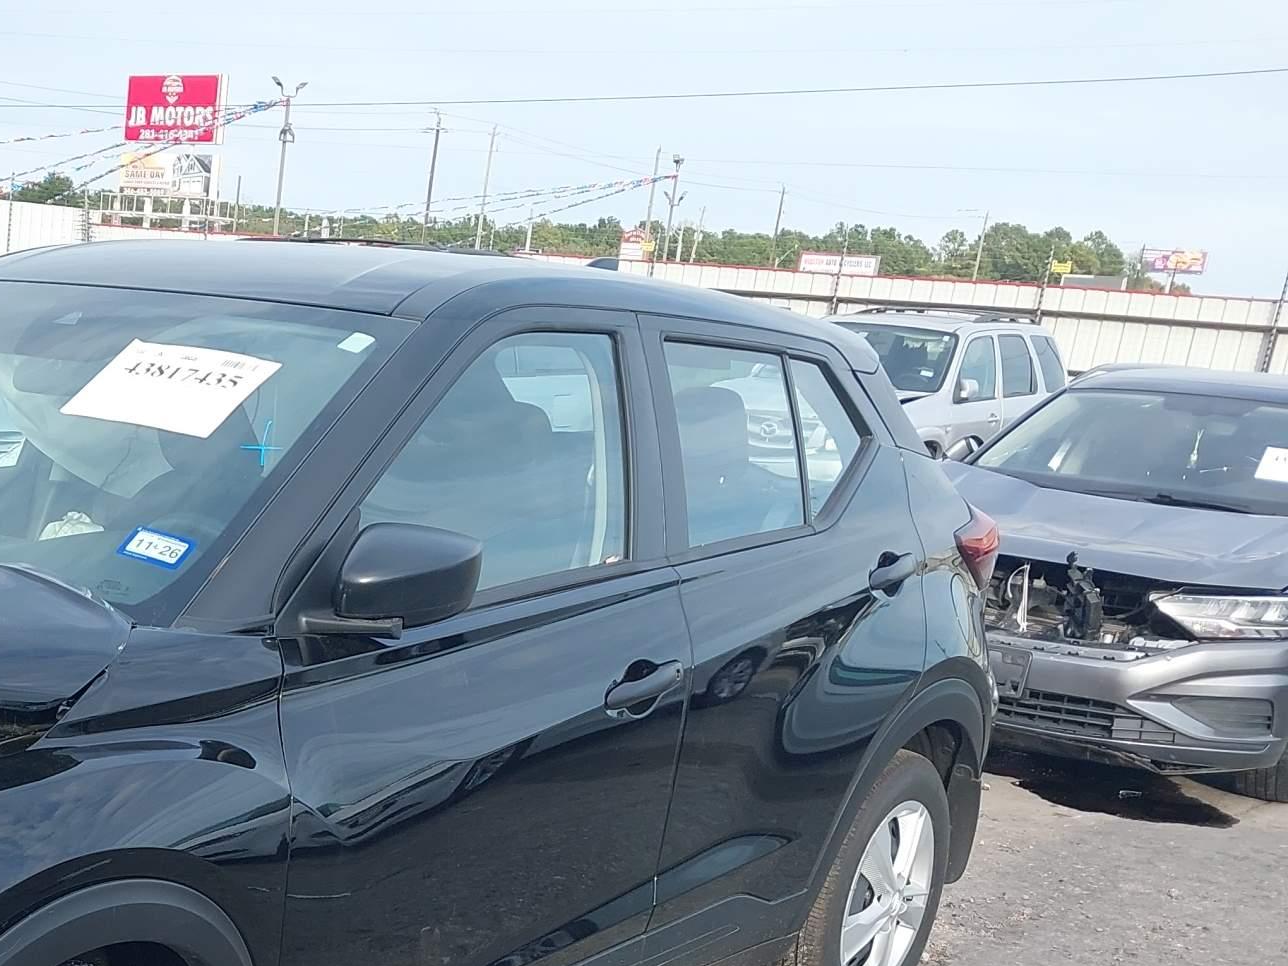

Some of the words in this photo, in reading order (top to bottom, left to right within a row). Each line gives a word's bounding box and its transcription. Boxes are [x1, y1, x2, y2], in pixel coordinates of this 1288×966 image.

[128, 106, 146, 127] JB
[150, 106, 214, 127] MOTORS
[124, 361, 244, 388] 43817435
